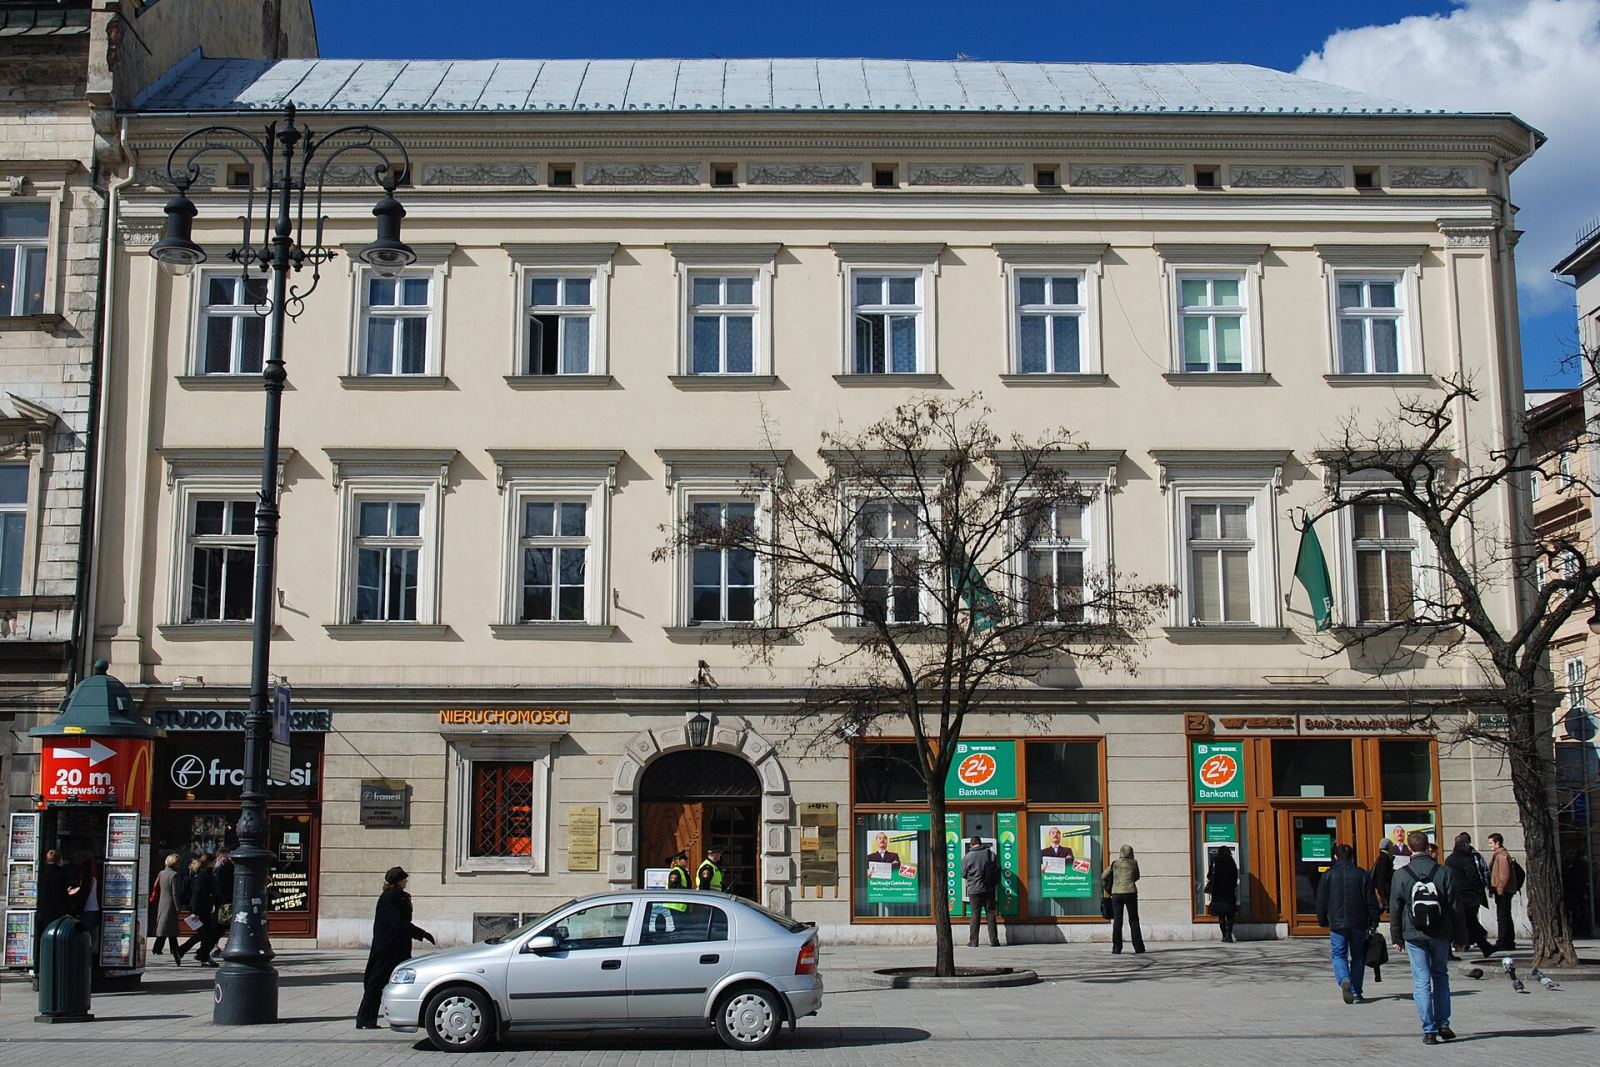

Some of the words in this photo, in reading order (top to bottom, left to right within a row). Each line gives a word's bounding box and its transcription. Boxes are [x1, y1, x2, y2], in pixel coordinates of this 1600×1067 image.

[155, 710, 224, 729] STUDIO
[439, 706, 570, 725] NIERUCHOMOŚCI
[56, 768, 83, 786] 20
[89, 772, 112, 786] m
[965, 759, 987, 777] 24
[1206, 760, 1228, 778] 24
[49, 786, 59, 795] ul.
[61, 785, 106, 795] Szewska
[108, 786, 115, 795] 2
[374, 791, 401, 801] framesi
[959, 788, 998, 796] Bankomat
[1200, 790, 1238, 798] Bankomat
